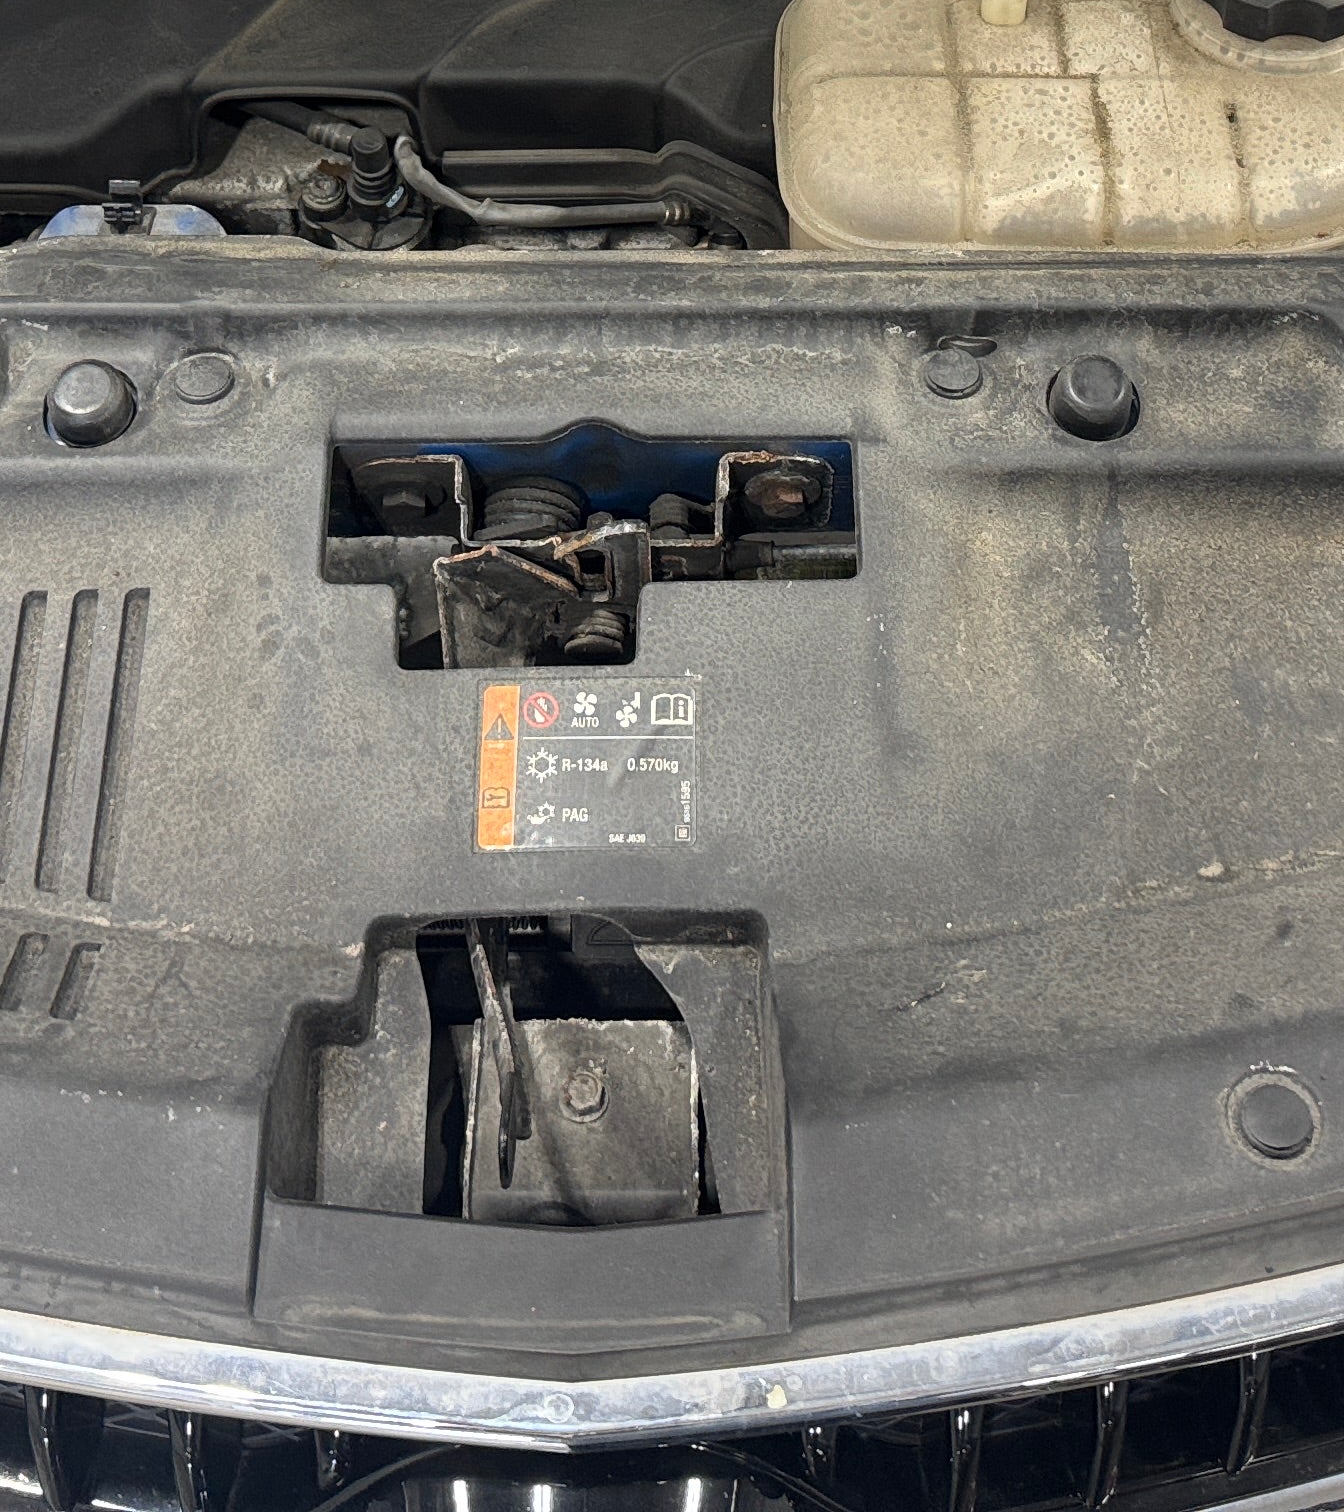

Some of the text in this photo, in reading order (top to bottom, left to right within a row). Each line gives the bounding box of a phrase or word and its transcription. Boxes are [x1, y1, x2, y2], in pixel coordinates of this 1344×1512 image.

[571, 716, 599, 728] AUTO
[561, 757, 679, 773] R-134a 0.570kg
[562, 807, 589, 822] PAG
[609, 833, 625, 844] SAE
